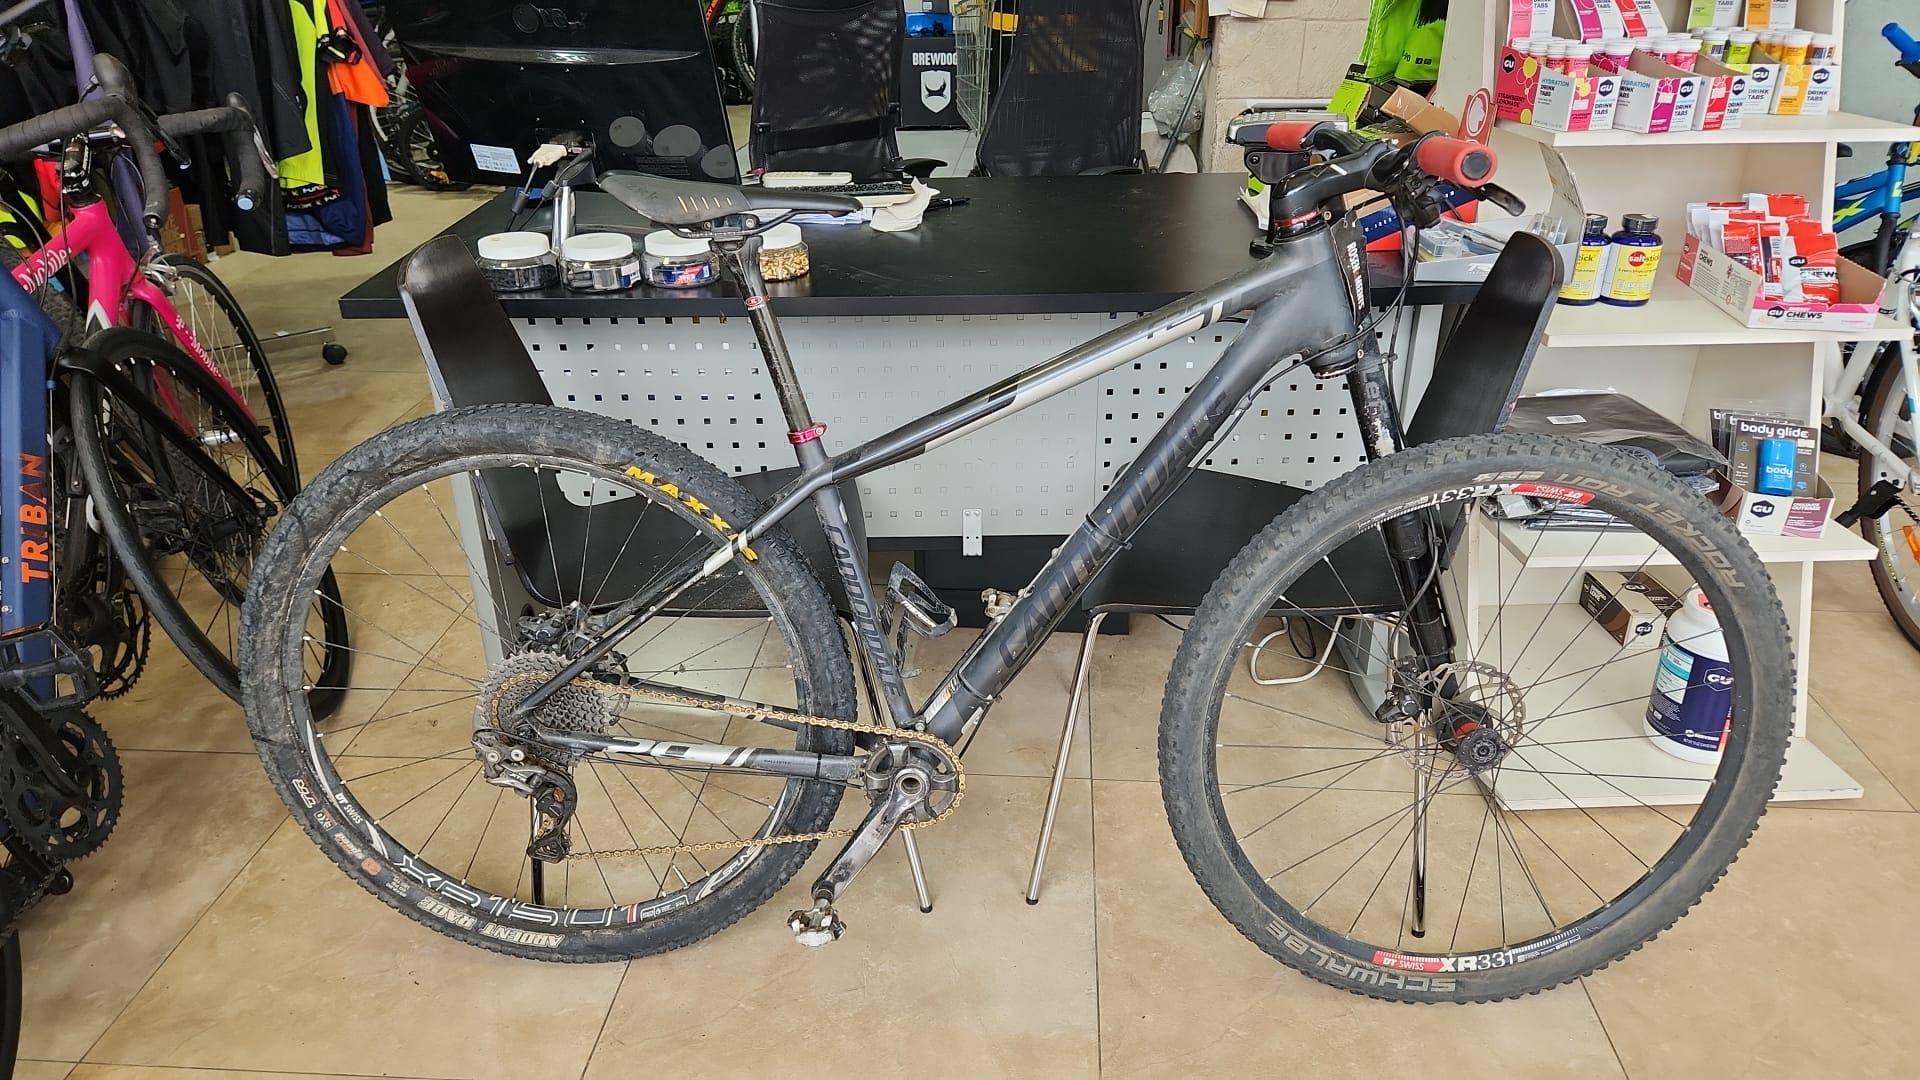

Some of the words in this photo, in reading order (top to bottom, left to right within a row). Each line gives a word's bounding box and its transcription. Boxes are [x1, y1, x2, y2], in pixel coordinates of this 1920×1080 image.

[1504, 60, 1515, 68] GU
[1540, 84, 1555, 92] DRINK
[1541, 78, 1570, 88] HYDRATION
[1599, 84, 1613, 93] GU
[1680, 85, 1693, 93] GU
[1733, 83, 1744, 91] GU
[1768, 309, 1783, 318] GU
[1786, 311, 1823, 319] CHEWS
[1740, 421, 1774, 437] body
[1776, 427, 1809, 438] glide
[1765, 465, 1793, 478] body
[1752, 504, 1773, 513] GU
[18, 453, 49, 583] TRIBAN
[999, 390, 1228, 667] CANNONDALE
[829, 524, 902, 696] CANNONDALE
[343, 803, 364, 825] SWISS
[416, 896, 478, 931] RACE
[479, 921, 566, 949] ARDENT
[1264, 920, 1457, 993] SCHWALBE
[1438, 950, 1517, 974] XR331
[1382, 956, 1397, 968] DT
[1398, 959, 1425, 972] SWISS
